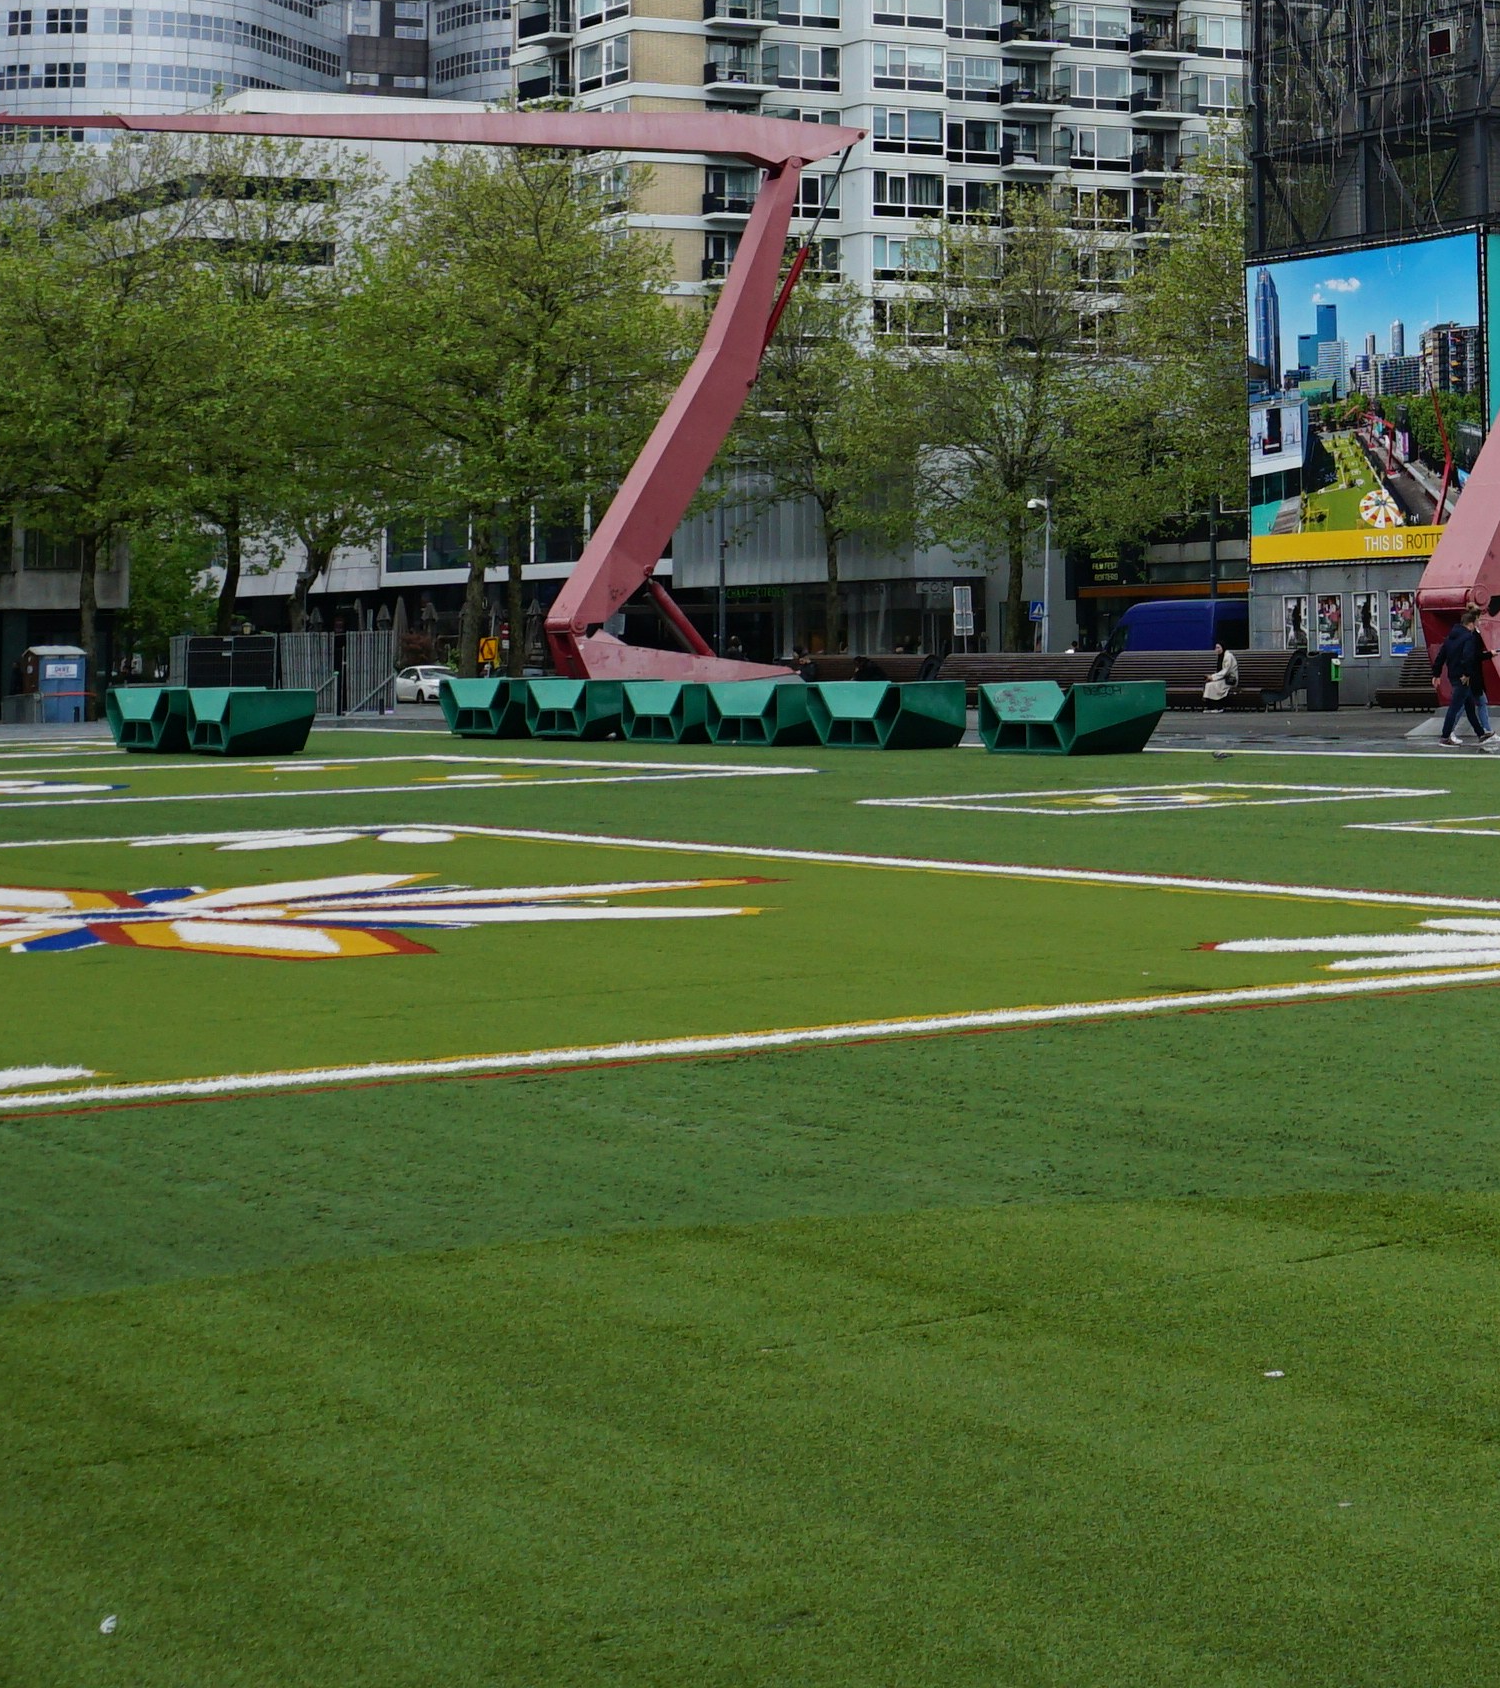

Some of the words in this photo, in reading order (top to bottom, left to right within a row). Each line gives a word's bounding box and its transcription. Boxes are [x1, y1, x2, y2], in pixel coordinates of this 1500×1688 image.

[1364, 536, 1390, 552] THIS
[1392, 534, 1403, 550] IS
[921, 582, 947, 592] COS
